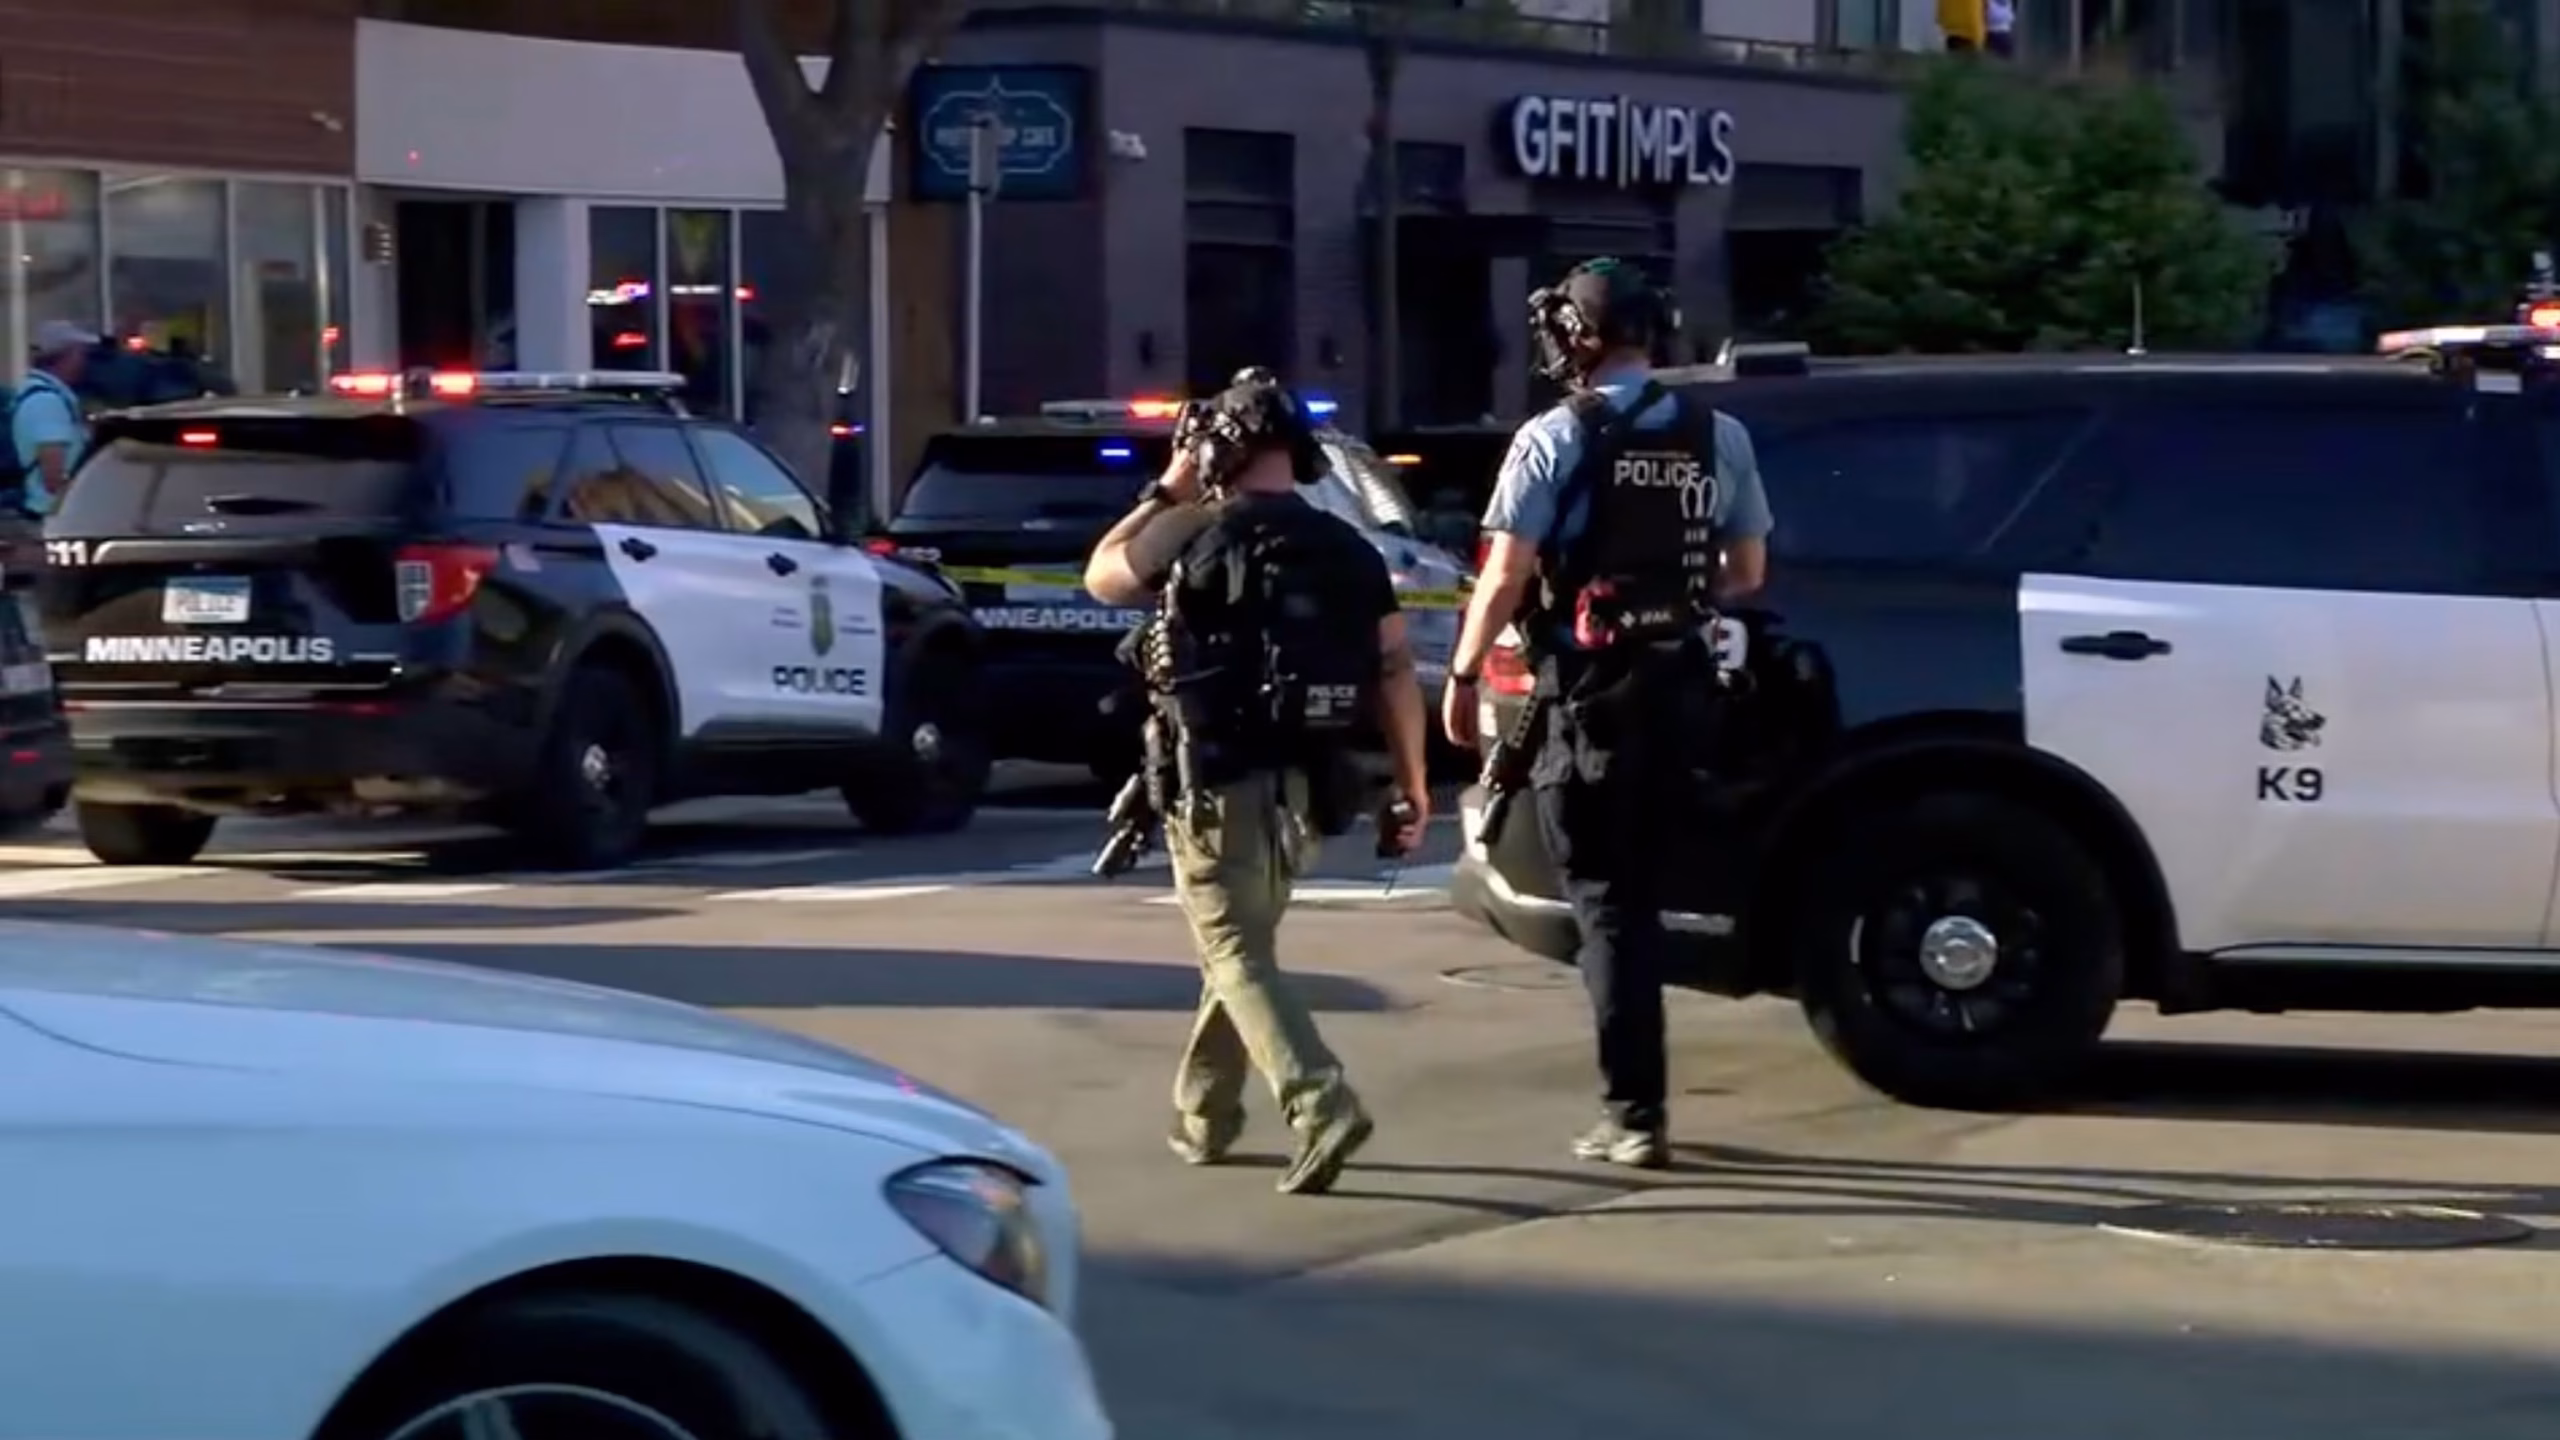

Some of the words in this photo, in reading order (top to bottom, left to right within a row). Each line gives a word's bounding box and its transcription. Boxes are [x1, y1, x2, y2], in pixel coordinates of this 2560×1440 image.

[1614, 460, 1700, 488] POLICE
[85, 637, 335, 663] MINNEAPOLIS
[773, 666, 865, 696] POLICE
[2258, 767, 2323, 801] K9
